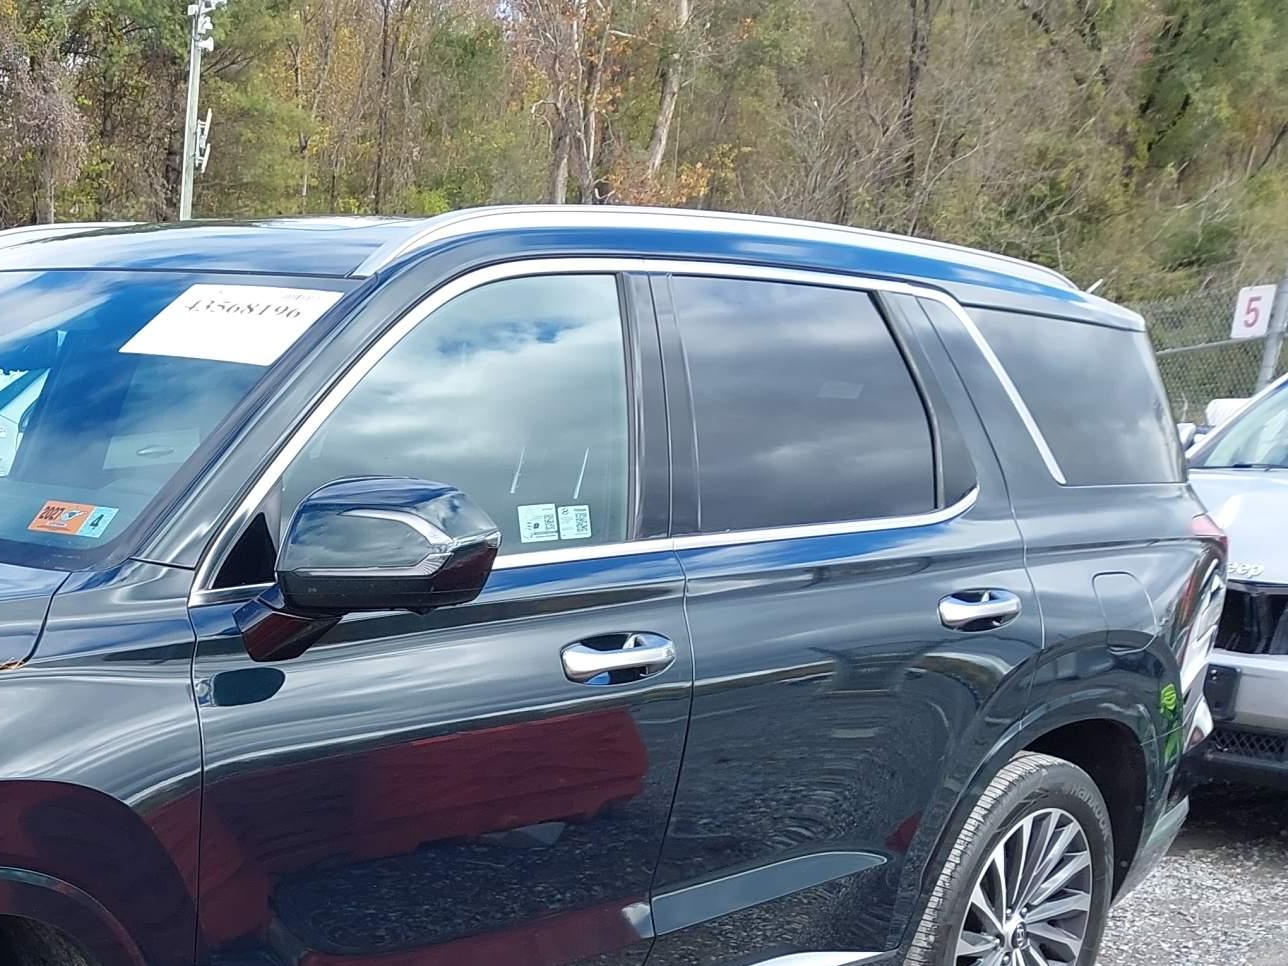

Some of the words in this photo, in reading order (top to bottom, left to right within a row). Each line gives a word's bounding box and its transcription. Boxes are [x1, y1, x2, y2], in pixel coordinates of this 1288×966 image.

[185, 299, 301, 319] 43568196
[1244, 295, 1262, 328] 5
[39, 506, 65, 520] 2027
[89, 513, 105, 528] 4
[1225, 560, 1264, 579] eep
